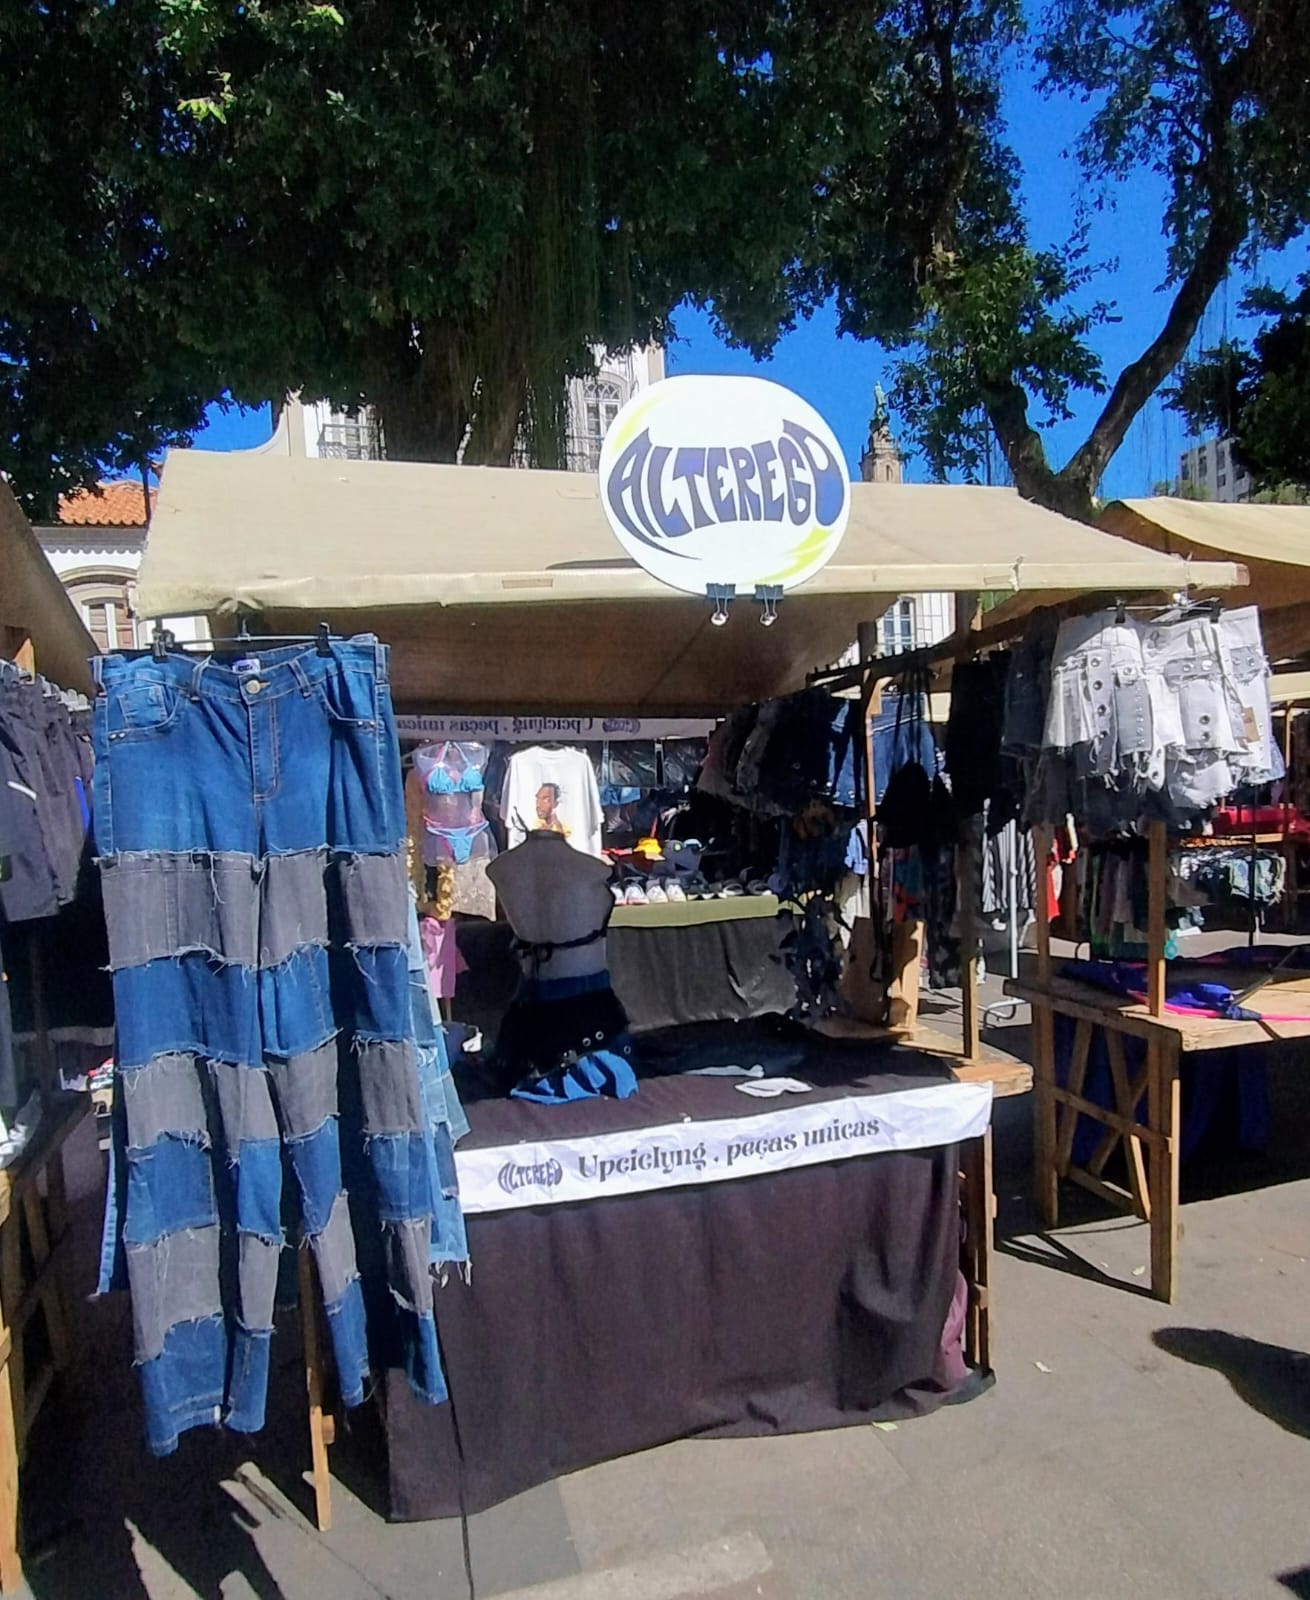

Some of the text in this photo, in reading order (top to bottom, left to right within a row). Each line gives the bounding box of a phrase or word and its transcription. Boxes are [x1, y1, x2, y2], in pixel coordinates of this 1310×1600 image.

[578, 1142, 707, 1182] Upciclyng
[727, 1133, 797, 1166] peças
[803, 1118, 880, 1147] unicas
